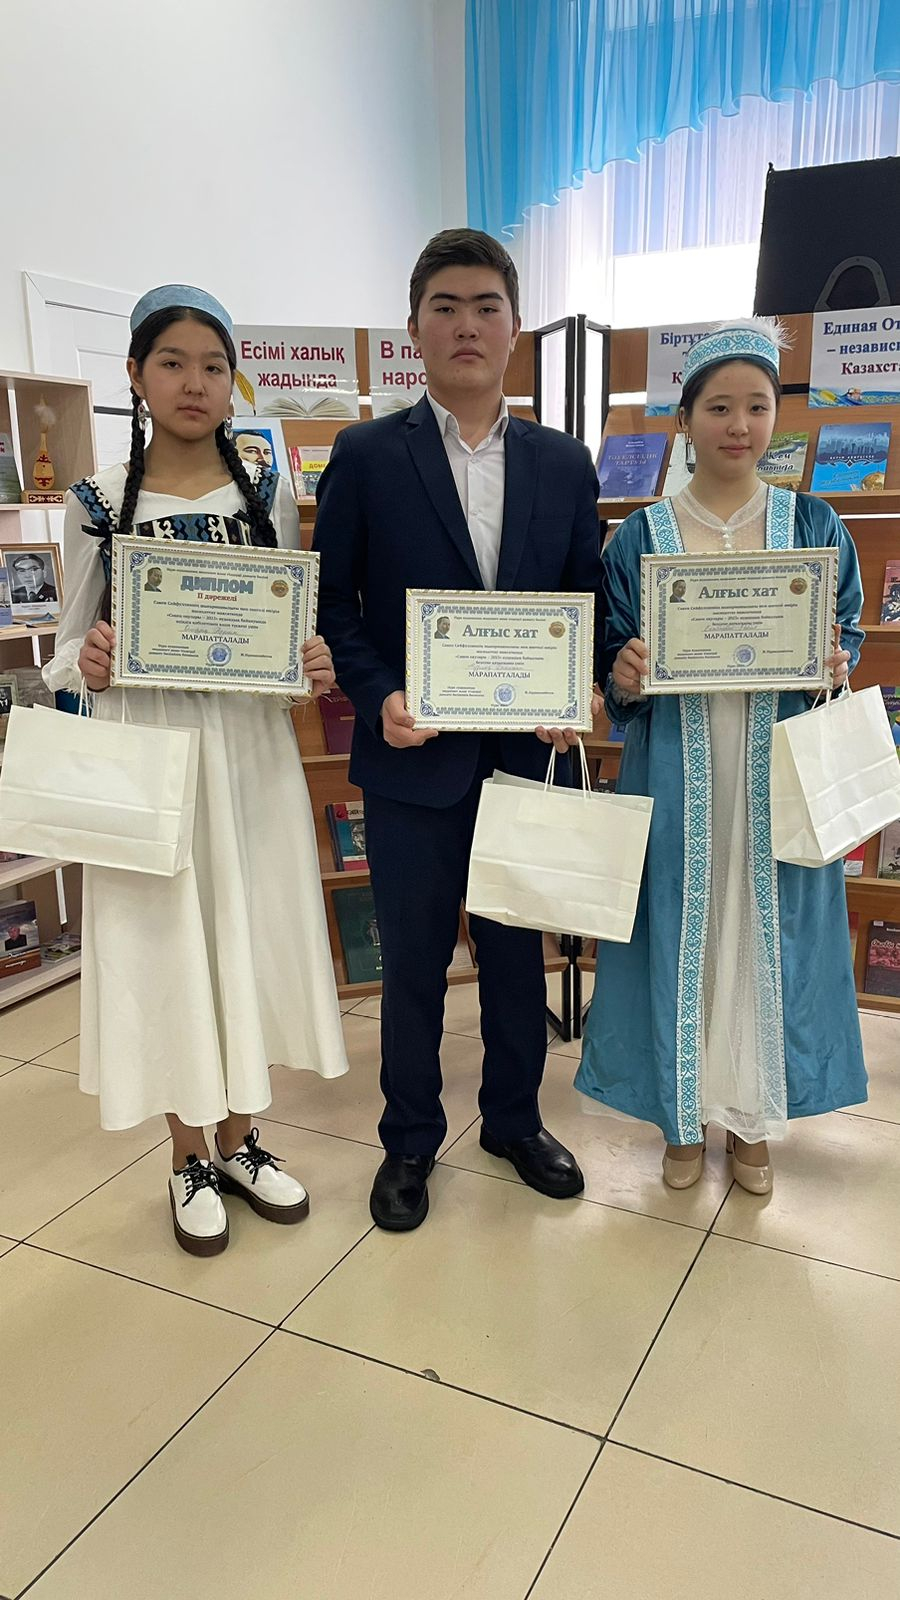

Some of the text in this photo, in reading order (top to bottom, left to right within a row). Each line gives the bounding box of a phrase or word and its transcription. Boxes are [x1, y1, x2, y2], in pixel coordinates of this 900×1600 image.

[823, 321, 877, 335] Единая
[661, 332, 710, 347] Біртұт
[240, 340, 345, 363] Есімі халық
[381, 341, 394, 359] В
[841, 362, 900, 375] Казахст
[257, 371, 337, 389] жадында
[383, 371, 427, 389] наро
[180, 576, 254, 594] ДИПЛОМ
[699, 586, 779, 599] Алғыс хат
[181, 633, 250, 645] МАРАПАТТАЛАДЫ
[462, 624, 539, 639] Алғыс хат
[704, 632, 769, 640] МАРАПАТТАЛАДЫ
[468, 671, 531, 679] МАРАПАТТАЛАДЫ
